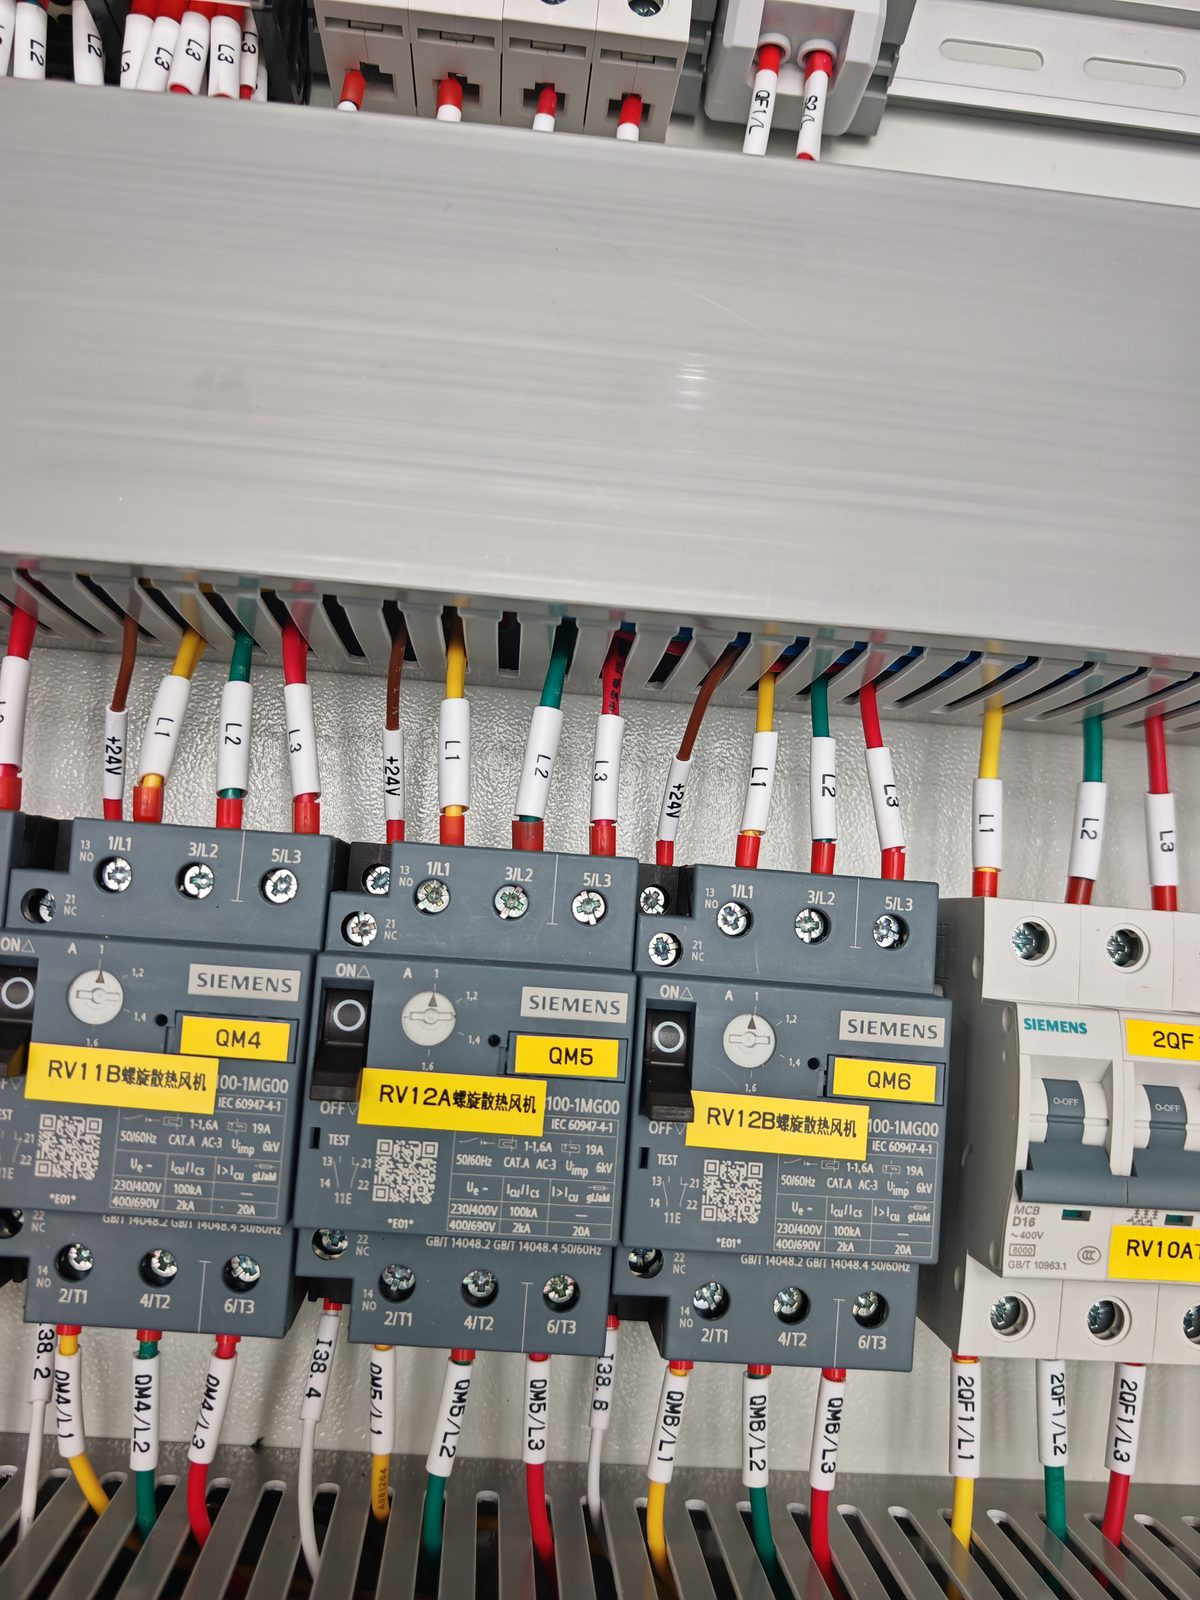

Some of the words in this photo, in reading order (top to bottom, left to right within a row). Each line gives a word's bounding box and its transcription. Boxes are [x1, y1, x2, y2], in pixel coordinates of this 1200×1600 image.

[87, 33, 102, 58] L2
[185, 38, 204, 62] L3
[242, 32, 258, 54] L3
[30, 38, 44, 66] L2
[154, 46, 174, 71] L3
[218, 44, 235, 64] L3
[154, 716, 174, 737] L1
[224, 722, 242, 746] L2
[288, 728, 302, 754] L3
[105, 736, 122, 776] +24V
[445, 740, 460, 760] L1
[534, 754, 551, 779] L2
[594, 760, 609, 782] L3
[384, 756, 400, 796] +24V
[750, 766, 768, 788] L1
[822, 772, 836, 798] L2
[665, 783, 685, 818] +24V
[883, 784, 900, 808] L3
[978, 814, 994, 833] L1
[1080, 817, 1100, 840] L2
[80, 840, 91, 850] 13
[108, 836, 132, 851] 1/L1
[1160, 830, 1174, 853] L3
[80, 851, 94, 862] NO
[188, 842, 218, 858] 3/L2
[271, 848, 302, 864] 5/L3
[400, 866, 409, 874] 13
[426, 862, 450, 876] 1/L1
[505, 866, 533, 882] 3/L2
[399, 876, 413, 887] NO
[583, 872, 611, 887] 5/L3
[65, 894, 75, 904] 21
[705, 888, 714, 897] 13
[731, 884, 754, 899] 1/L1
[808, 890, 835, 906] 3/L2
[64, 906, 77, 916] NC
[704, 899, 718, 909] NO
[885, 896, 913, 912] 5/L3
[386, 919, 396, 928] 21
[384, 930, 397, 940] NC
[1, 938, 20, 952] ON
[692, 941, 702, 949] 21
[692, 952, 704, 962] NC
[336, 963, 356, 978] ON
[196, 972, 292, 993] SIEMENS
[660, 984, 679, 999] ON
[529, 994, 620, 1015] SIEMENS
[848, 1019, 938, 1039] SIEMENS
[1024, 1018, 1087, 1034] SIEMENS
[216, 1028, 262, 1049] QM4
[1153, 1030, 1200, 1050] 2QF
[549, 1047, 593, 1066] QM5
[48, 1059, 206, 1091] RV11B螺旋散热风机
[867, 1070, 911, 1090] QM6
[217, 1074, 288, 1094] 00-1MG00
[218, 1097, 233, 1108] IEC
[379, 1084, 536, 1114] RV12A螺旋散热风机
[547, 1096, 620, 1115] 100-1MG00
[320, 1101, 345, 1115] OFF
[252, 1123, 271, 1134] 19A
[551, 1118, 566, 1129] IEC
[568, 1120, 613, 1133] 60947-4-1
[649, 1121, 672, 1134] OFF
[707, 1107, 856, 1138] RV12B螺旋散热风机
[328, 1134, 350, 1146] TEST
[872, 1141, 887, 1151] IEC
[889, 1142, 933, 1154] 60947-4-1
[586, 1144, 604, 1155] 19A
[456, 1154, 492, 1167] 50/60Hz
[536, 1159, 557, 1170] AC-3
[596, 1162, 612, 1174] 6kV
[657, 1154, 678, 1166] TEST
[906, 1166, 924, 1176] 19A
[113, 1180, 162, 1194] 230/400V
[174, 1184, 202, 1196] 100kA
[781, 1174, 816, 1187] 50/60Hz
[858, 1180, 878, 1191] AC-3
[916, 1183, 932, 1193] 6kV
[176, 1200, 195, 1211] 2kA
[334, 1192, 352, 1204] 11E
[32, 1210, 45, 1220] 22
[237, 1204, 255, 1215] 20A
[450, 1203, 498, 1216] 230/400V
[510, 1206, 538, 1218] 100kA
[1014, 1205, 1040, 1215] MCB
[664, 1212, 681, 1224] 11E
[1012, 1216, 1036, 1227] D16
[31, 1222, 45, 1232] NC
[449, 1220, 496, 1232] 400/690V
[512, 1222, 531, 1234] 2kA
[572, 1226, 590, 1236] 20A
[777, 1223, 822, 1236] 230/400V
[834, 1226, 861, 1237] 100kA
[357, 1235, 368, 1245] 22
[426, 1236, 448, 1247] GB/T
[451, 1237, 490, 1250] 14048.2
[494, 1239, 516, 1250] GB/T
[519, 1241, 558, 1254] 14048.4
[561, 1244, 602, 1256] 50/60Hz
[776, 1239, 820, 1251] 400/690V
[837, 1242, 854, 1252] 2kA
[356, 1246, 370, 1256] NC
[894, 1245, 912, 1255] 20A
[1126, 1239, 1200, 1259] RV10A
[674, 1253, 685, 1263] 22
[740, 1254, 762, 1265] GB/T
[766, 1255, 803, 1267] 14048.2
[806, 1258, 827, 1268] GB/T
[830, 1259, 868, 1271] 14048.4
[871, 1261, 910, 1273] 50/60Hz
[1008, 1261, 1030, 1269] GB/T
[1034, 1261, 1067, 1270] 10963.1
[38, 1266, 48, 1275] 14
[672, 1264, 686, 1274] NC
[36, 1277, 51, 1288] NO
[58, 1288, 87, 1304] 2/T1
[362, 1289, 373, 1299] 14
[140, 1294, 170, 1310] 4/T2
[224, 1298, 254, 1314] 6/T3
[362, 1300, 377, 1311] NO
[384, 1311, 413, 1326] 2/T1
[680, 1306, 690, 1316] 14
[464, 1316, 494, 1330] 4/T2
[547, 1319, 576, 1334] 6/T3
[679, 1318, 694, 1328] NO
[701, 1328, 728, 1343] 2/T1
[778, 1332, 807, 1347] 4/T2
[857, 1335, 887, 1350] 6/T3
[133, 1374, 152, 1453] QM4/L2
[439, 1378, 470, 1458] QM5/L2
[528, 1379, 547, 1451] QM5/L3
[958, 1375, 975, 1460] 2QF1/L1
[1050, 1372, 1067, 1456] 2QF1/L2
[1114, 1378, 1138, 1463] 2QF1/L3
[657, 1391, 684, 1462] QM6/L1
[749, 1395, 767, 1472] QM6/L2
[821, 1398, 844, 1474] QM6/L3
